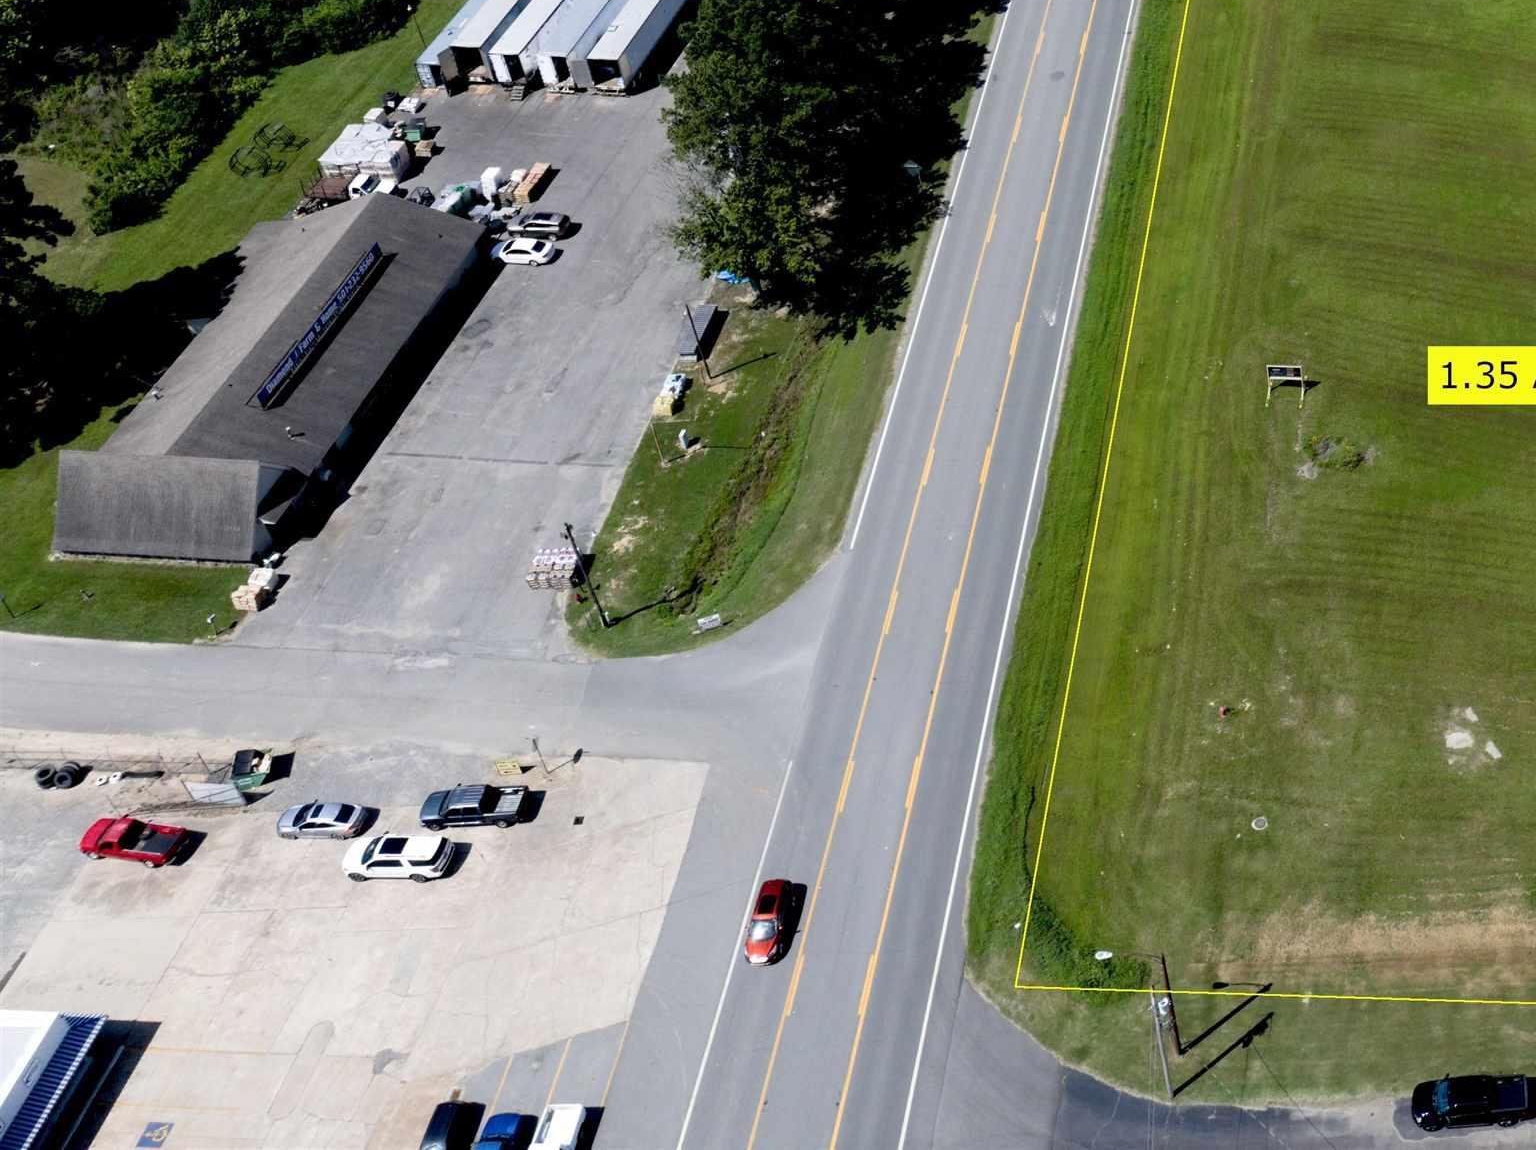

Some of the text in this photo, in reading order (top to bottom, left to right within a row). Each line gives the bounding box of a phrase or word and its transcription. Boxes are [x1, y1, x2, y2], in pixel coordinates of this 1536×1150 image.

[299, 330, 316, 353] Farm
[314, 323, 322, 333] &
[320, 301, 339, 324] Home
